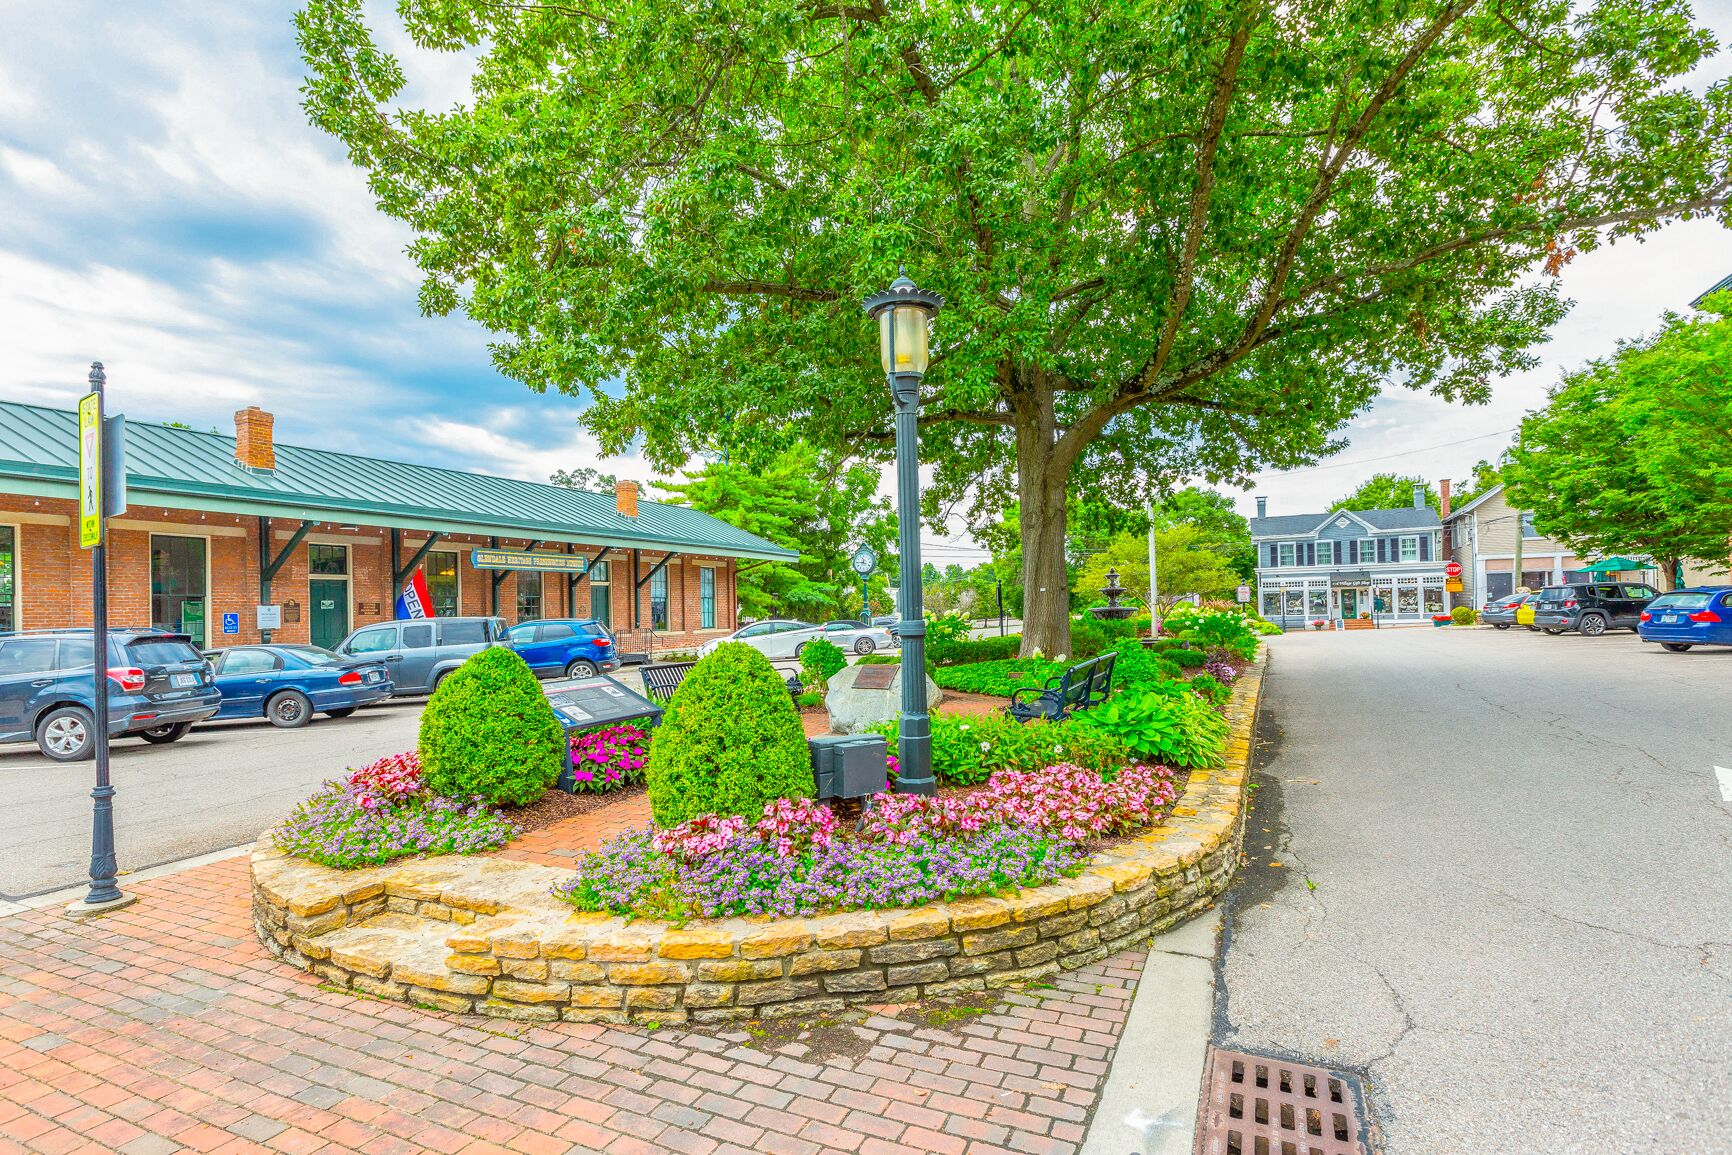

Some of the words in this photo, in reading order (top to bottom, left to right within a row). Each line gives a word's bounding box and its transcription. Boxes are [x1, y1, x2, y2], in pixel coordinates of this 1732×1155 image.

[82, 397, 96, 411] STATE
[84, 414, 94, 428] LAW
[86, 466, 93, 480] TO
